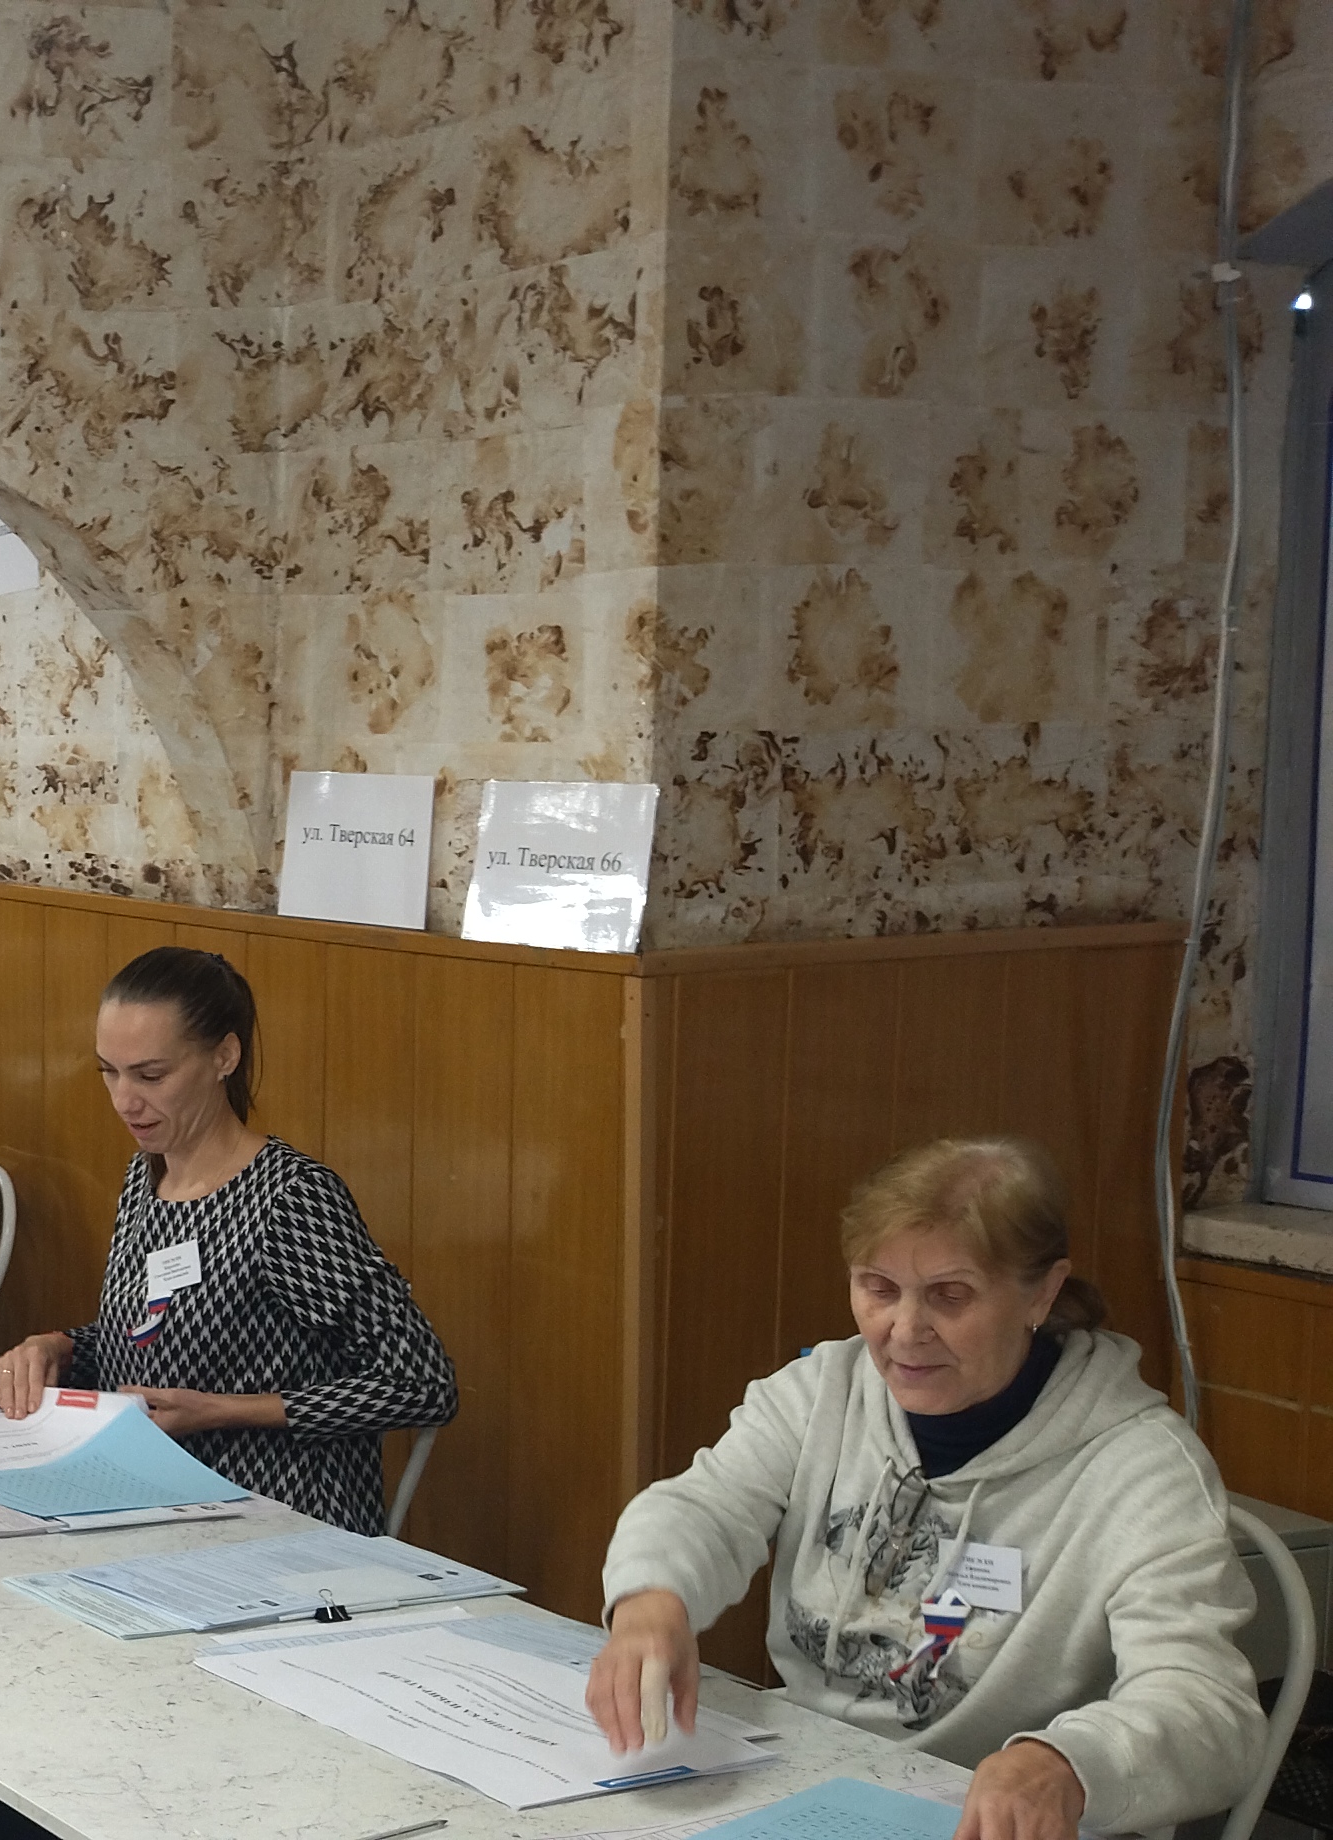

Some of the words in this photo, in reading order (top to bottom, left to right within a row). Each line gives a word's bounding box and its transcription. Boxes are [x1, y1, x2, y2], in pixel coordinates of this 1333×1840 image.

[302, 827, 323, 844] ул.
[329, 823, 394, 848] Тверская
[398, 828, 415, 847] 64
[486, 851, 511, 869] ул.
[518, 847, 595, 873] Тверская
[600, 851, 623, 872] 66
